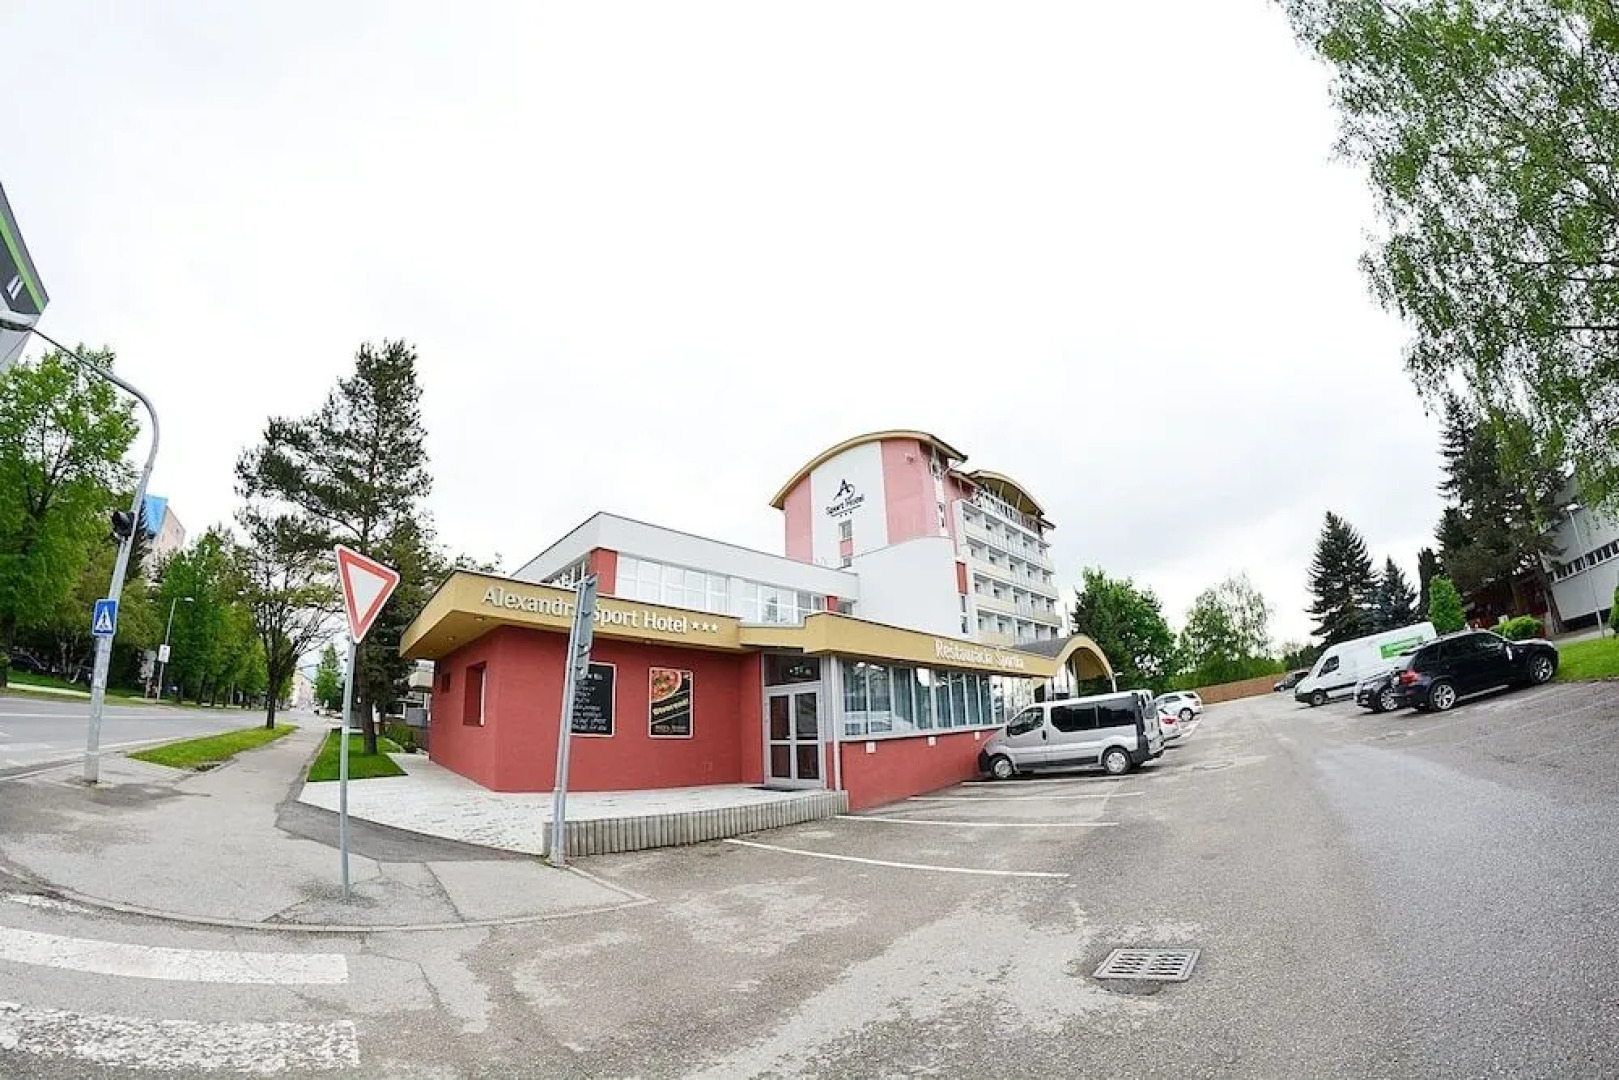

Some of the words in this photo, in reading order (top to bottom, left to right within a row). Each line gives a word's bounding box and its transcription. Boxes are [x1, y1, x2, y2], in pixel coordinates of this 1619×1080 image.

[481, 585, 575, 617] Alexandr
[592, 598, 638, 628] Sport
[643, 610, 687, 634] Hotel
